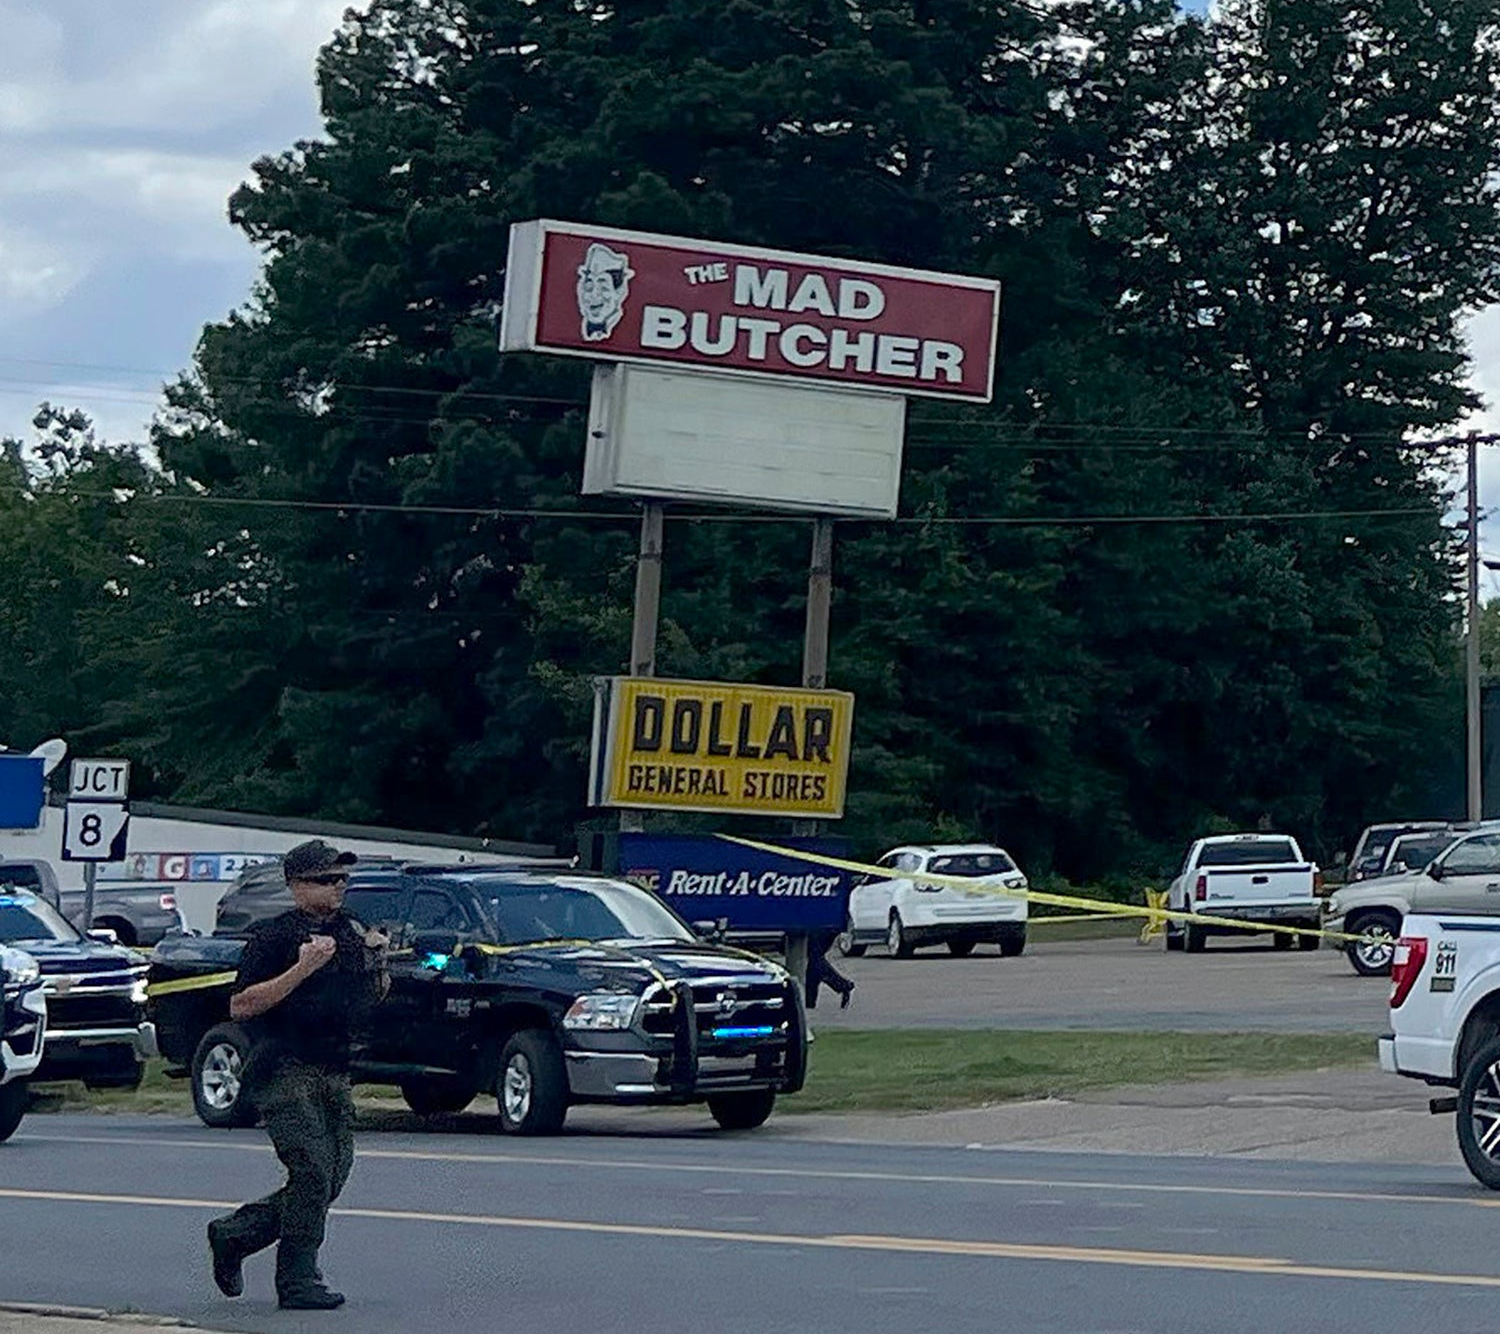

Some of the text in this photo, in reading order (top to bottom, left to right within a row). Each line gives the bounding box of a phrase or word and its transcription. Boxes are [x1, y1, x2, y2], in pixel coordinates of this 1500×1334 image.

[684, 262, 885, 321] THE MAD
[640, 305, 965, 384] BUTCHER
[632, 694, 834, 764] DOLLAR
[75, 767, 124, 792] JCT
[627, 764, 828, 802] GENERAL STORES
[79, 813, 101, 846] 8
[1435, 953, 1457, 974] 911
